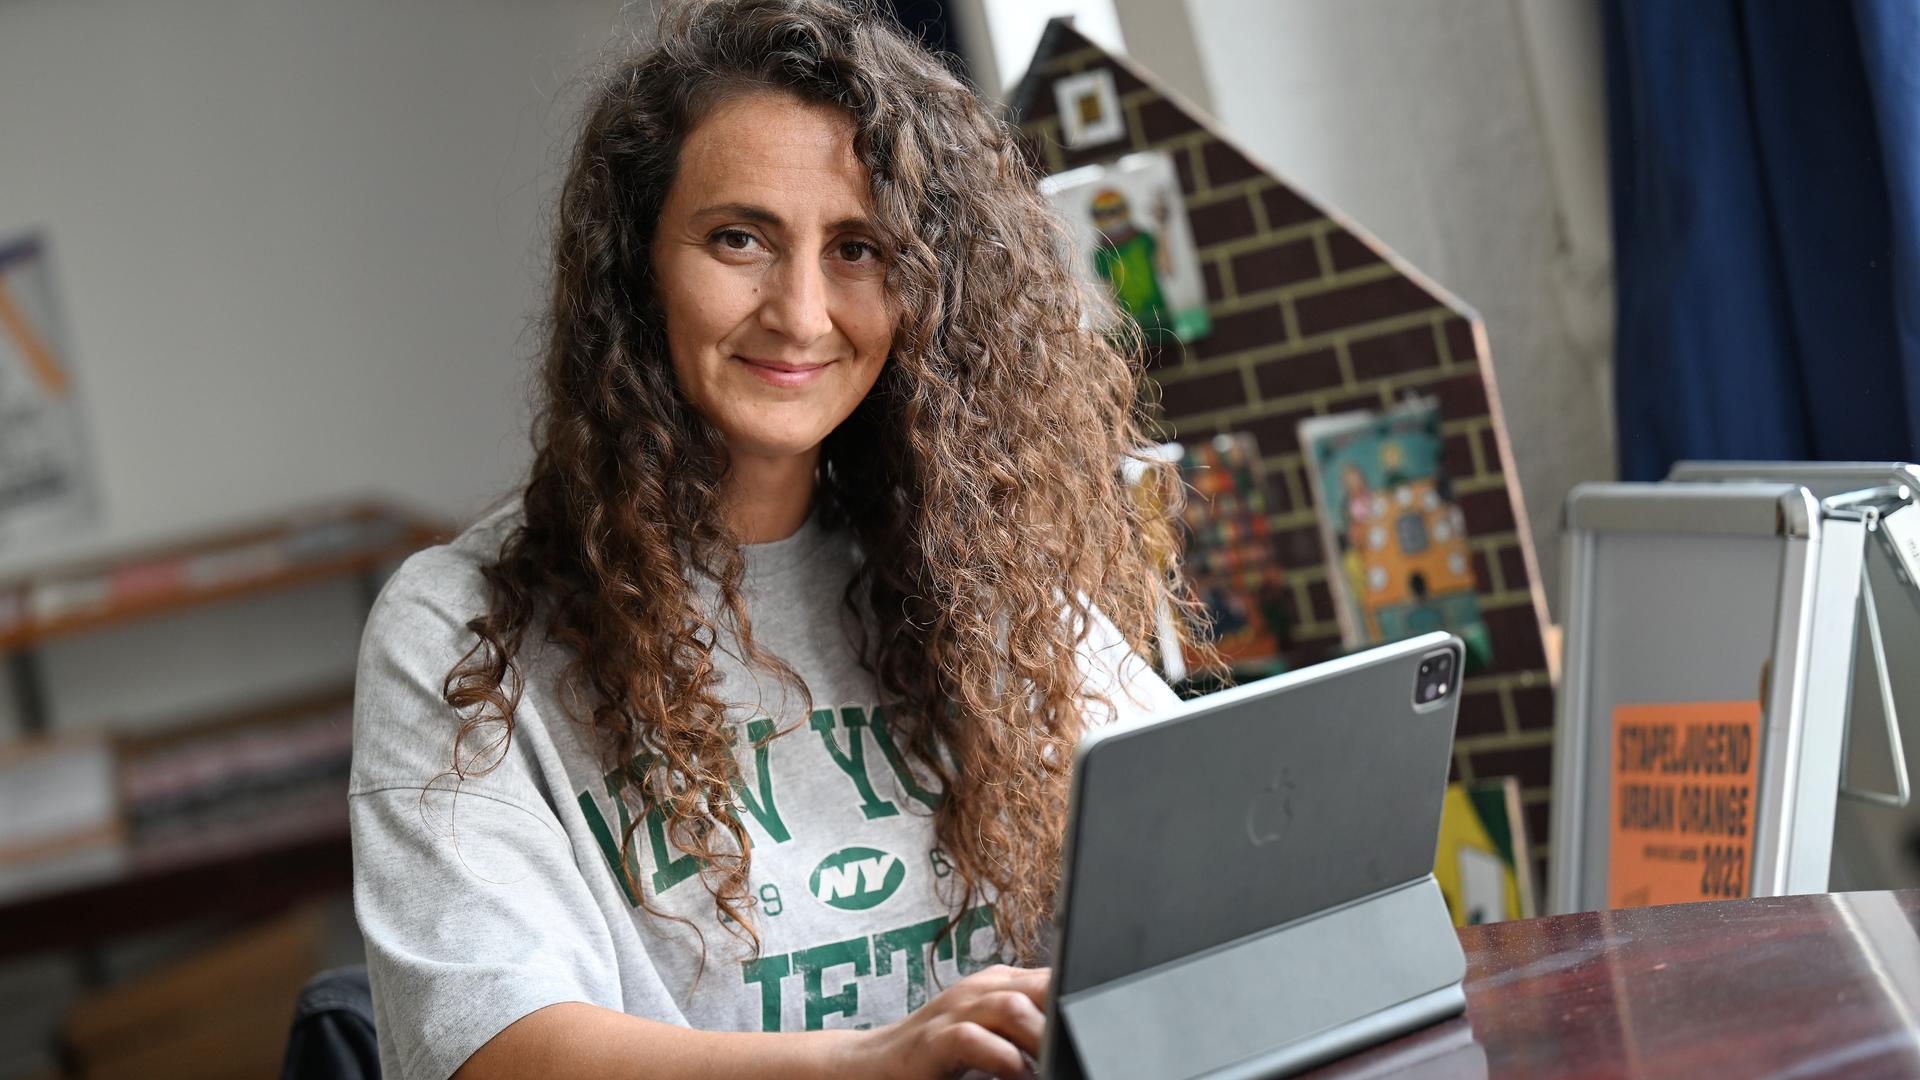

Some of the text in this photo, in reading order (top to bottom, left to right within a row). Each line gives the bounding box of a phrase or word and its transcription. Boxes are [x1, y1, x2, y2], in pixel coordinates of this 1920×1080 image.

[1620, 724, 1751, 775] STAPELJUGEND
[1621, 784, 1748, 838] URBAN ORANGE
[818, 855, 896, 903] NY
[1702, 844, 1744, 897] 2023
